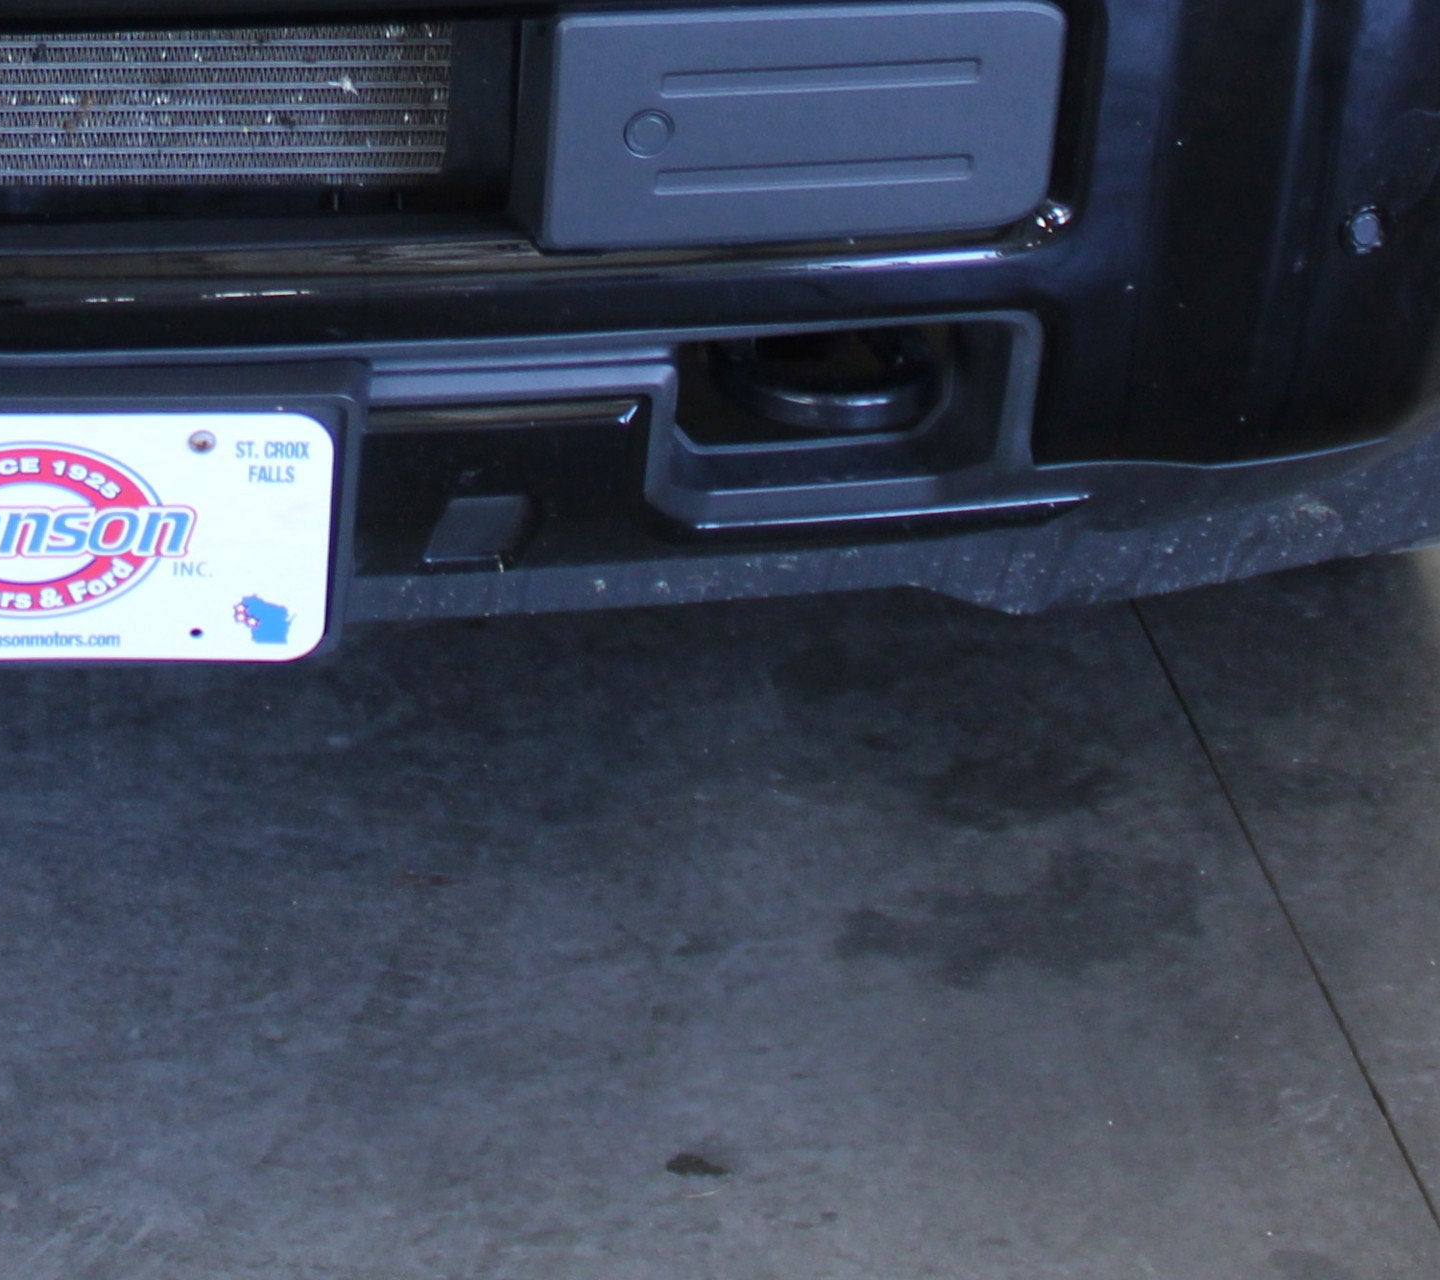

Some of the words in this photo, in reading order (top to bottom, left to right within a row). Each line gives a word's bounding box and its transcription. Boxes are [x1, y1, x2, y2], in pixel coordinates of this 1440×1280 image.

[235, 441, 259, 459] ST.
[264, 441, 310, 459] CROIX
[51, 460, 123, 500] 1925
[248, 465, 295, 483] FALLS
[173, 561, 213, 578] INC.
[39, 588, 66, 609] &
[66, 557, 136, 603] Ford
